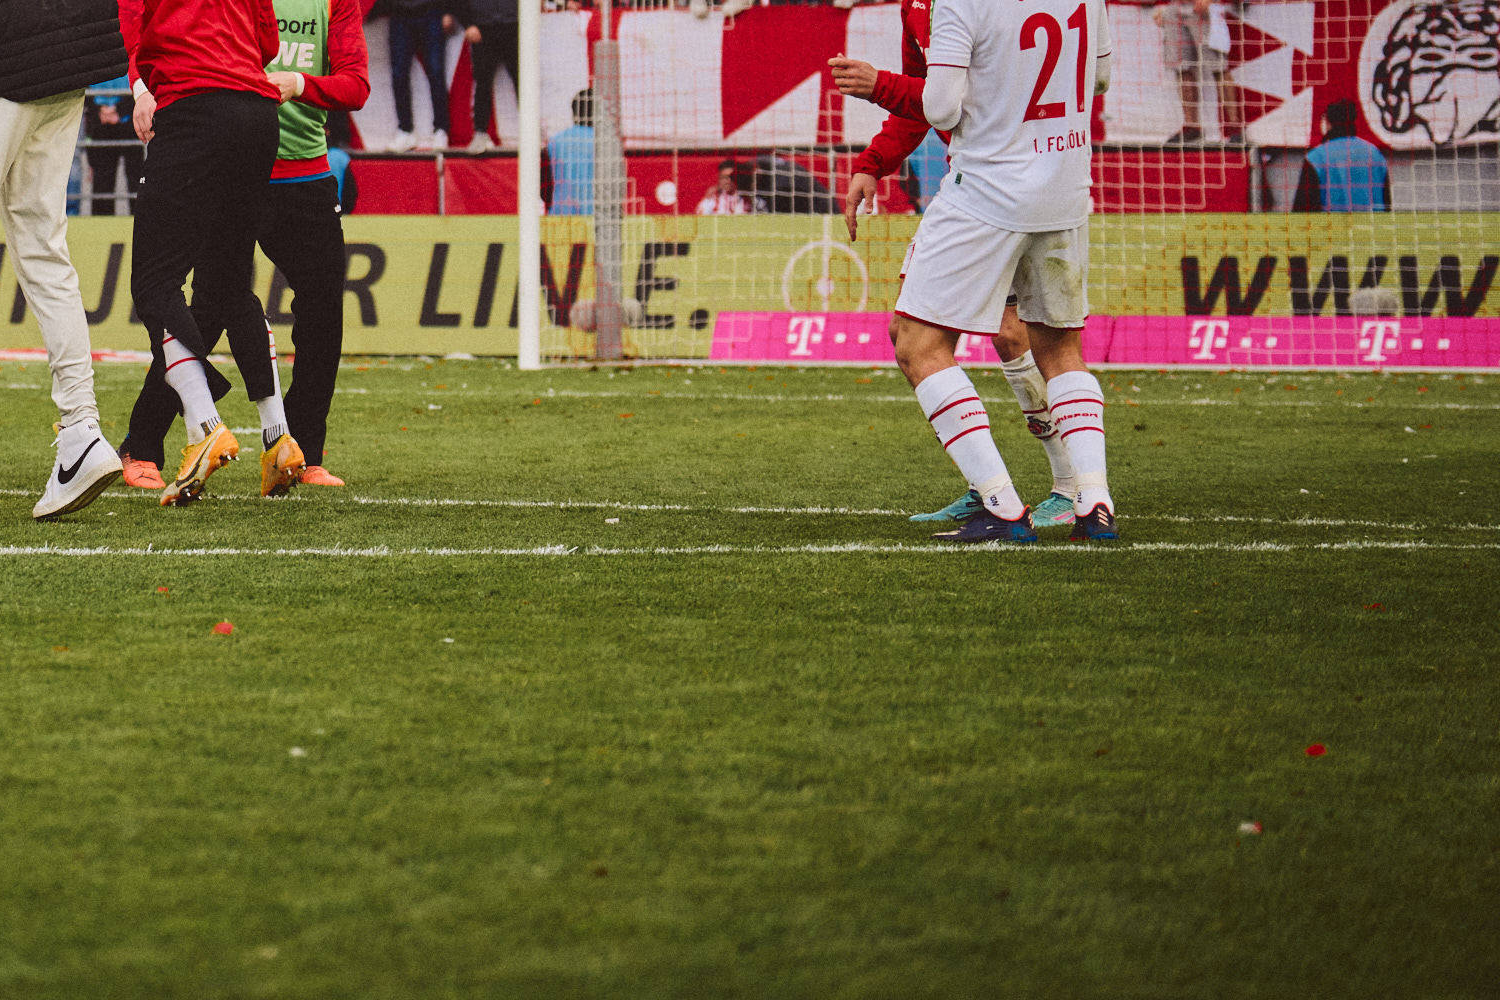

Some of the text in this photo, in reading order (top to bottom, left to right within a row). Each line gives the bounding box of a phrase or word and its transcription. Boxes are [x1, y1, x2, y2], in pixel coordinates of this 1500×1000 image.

[277, 18, 317, 36] port
[269, 41, 315, 67] WE
[1019, 3, 1088, 123] 21
[1047, 136, 1065, 153] FC
[1066, 130, 1086, 151] ÖLN
